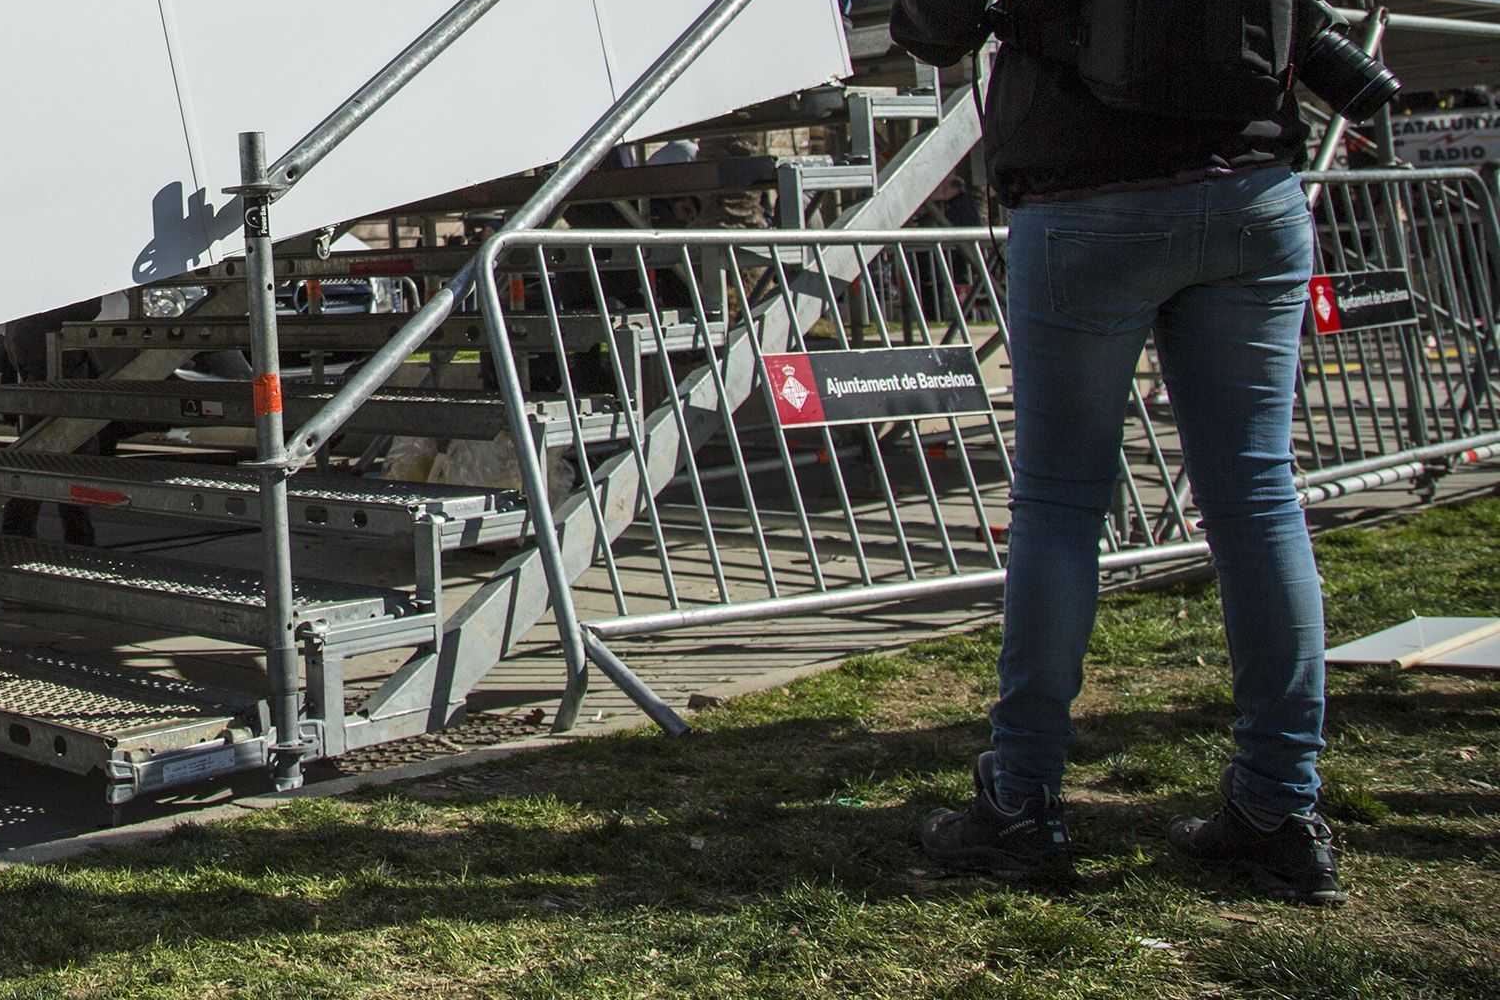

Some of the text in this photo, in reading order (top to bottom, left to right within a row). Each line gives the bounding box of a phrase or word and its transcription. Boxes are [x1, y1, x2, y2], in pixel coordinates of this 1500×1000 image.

[826, 371, 975, 398] Ajuntament de Barcelona
